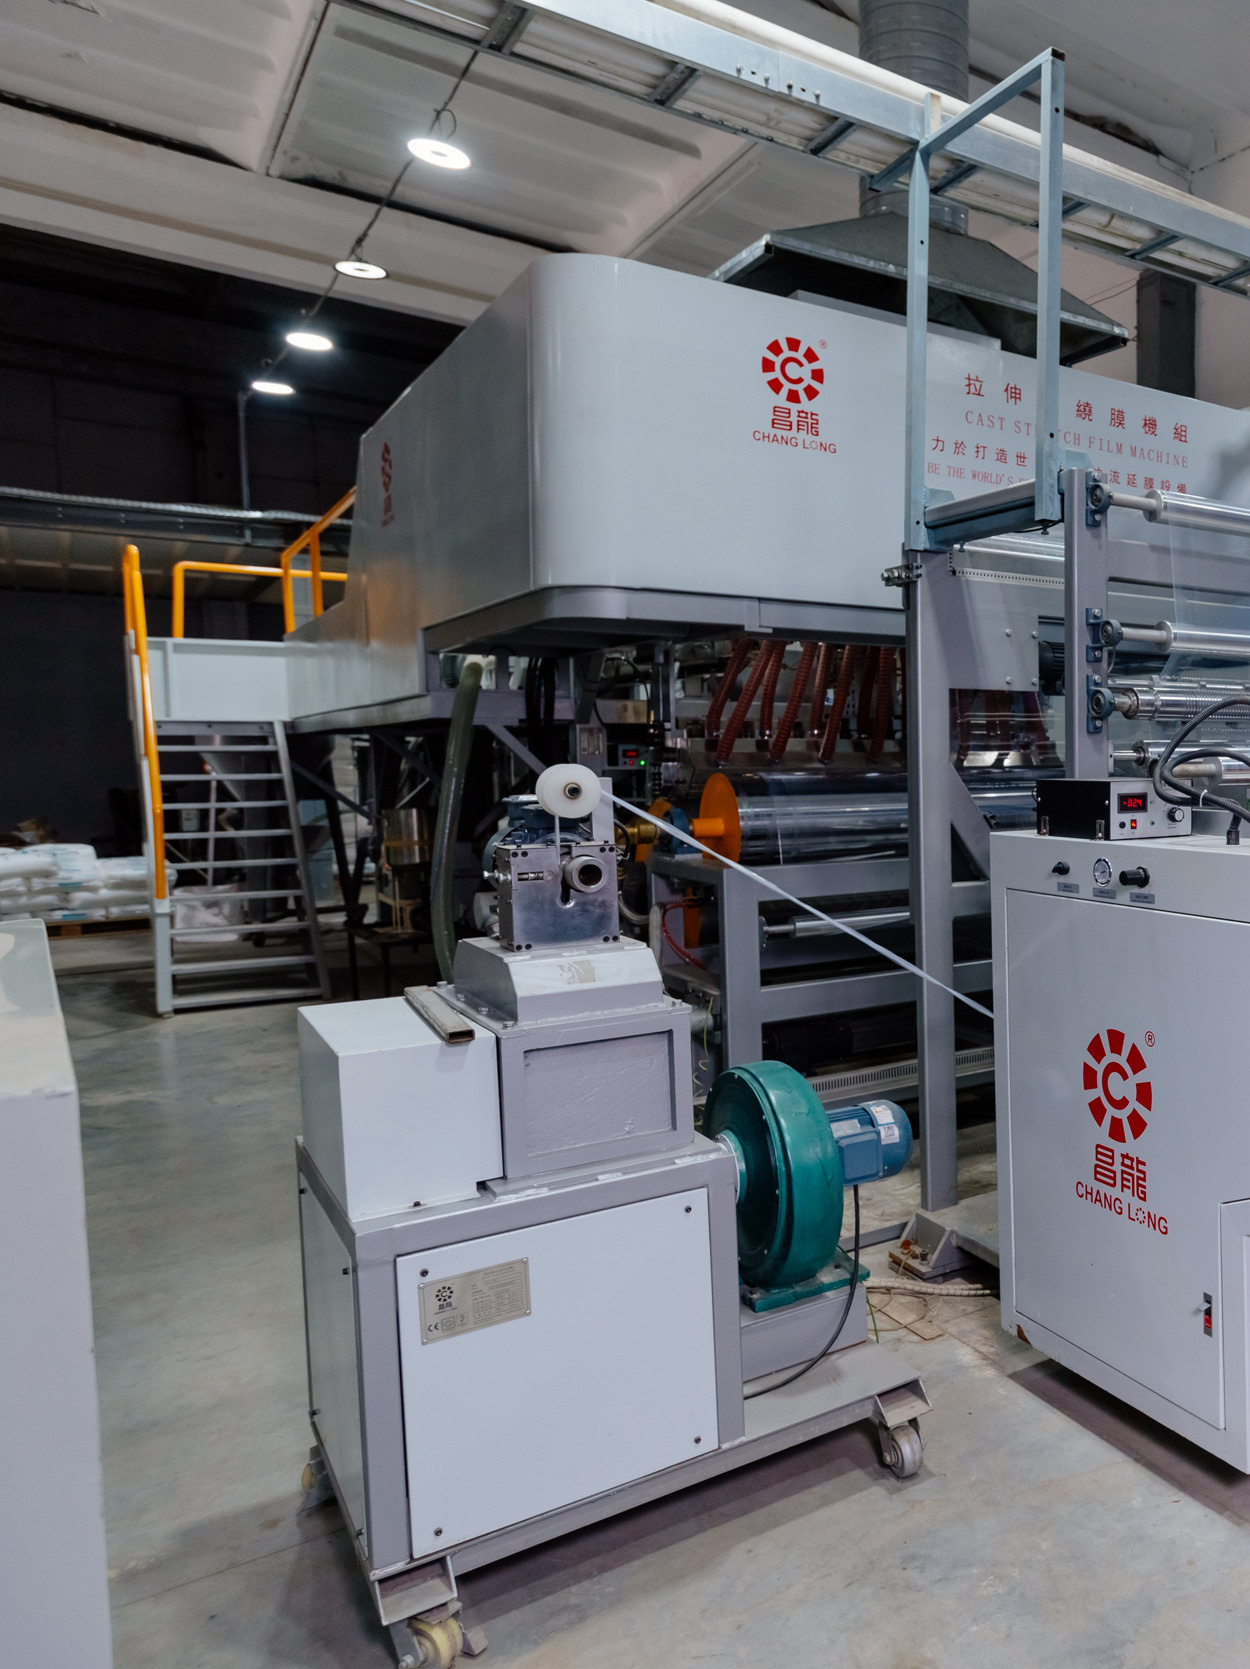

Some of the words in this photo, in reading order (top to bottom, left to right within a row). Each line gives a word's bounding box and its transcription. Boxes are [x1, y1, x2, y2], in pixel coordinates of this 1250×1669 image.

[771, 405, 819, 437] 昌龍
[964, 373, 1188, 443] 拉伸繞膜機組
[752, 430, 799, 448] CHANG
[802, 438, 838, 454] LONG
[965, 410, 1005, 431] CAST
[1014, 420, 1081, 446] STCH
[1088, 435, 1123, 455] FILM
[1130, 445, 1189, 469] MACHINE
[927, 461, 941, 475] BE
[947, 464, 966, 479] THE
[971, 469, 1014, 486] WORLD'S
[1093, 1143, 1147, 1202] 昌龍
[1075, 1181, 1123, 1215] CHANG
[1127, 1202, 1169, 1235] LONG
